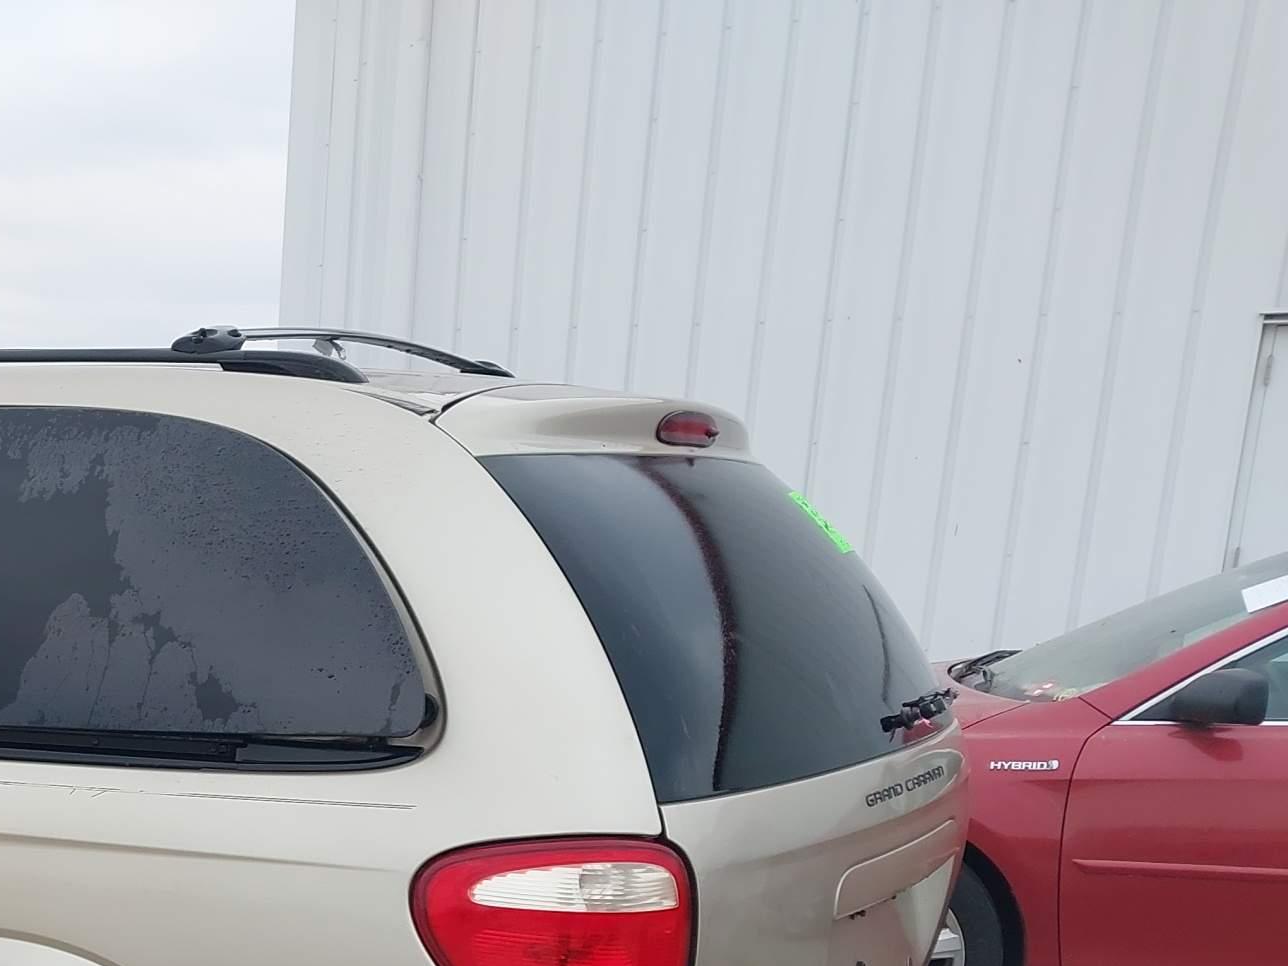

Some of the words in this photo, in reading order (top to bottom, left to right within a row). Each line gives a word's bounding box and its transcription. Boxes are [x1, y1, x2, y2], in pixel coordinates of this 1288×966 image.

[989, 760, 1049, 771] HYBRID
[865, 783, 904, 808] GRAND
[905, 765, 945, 792] CARAVAN
